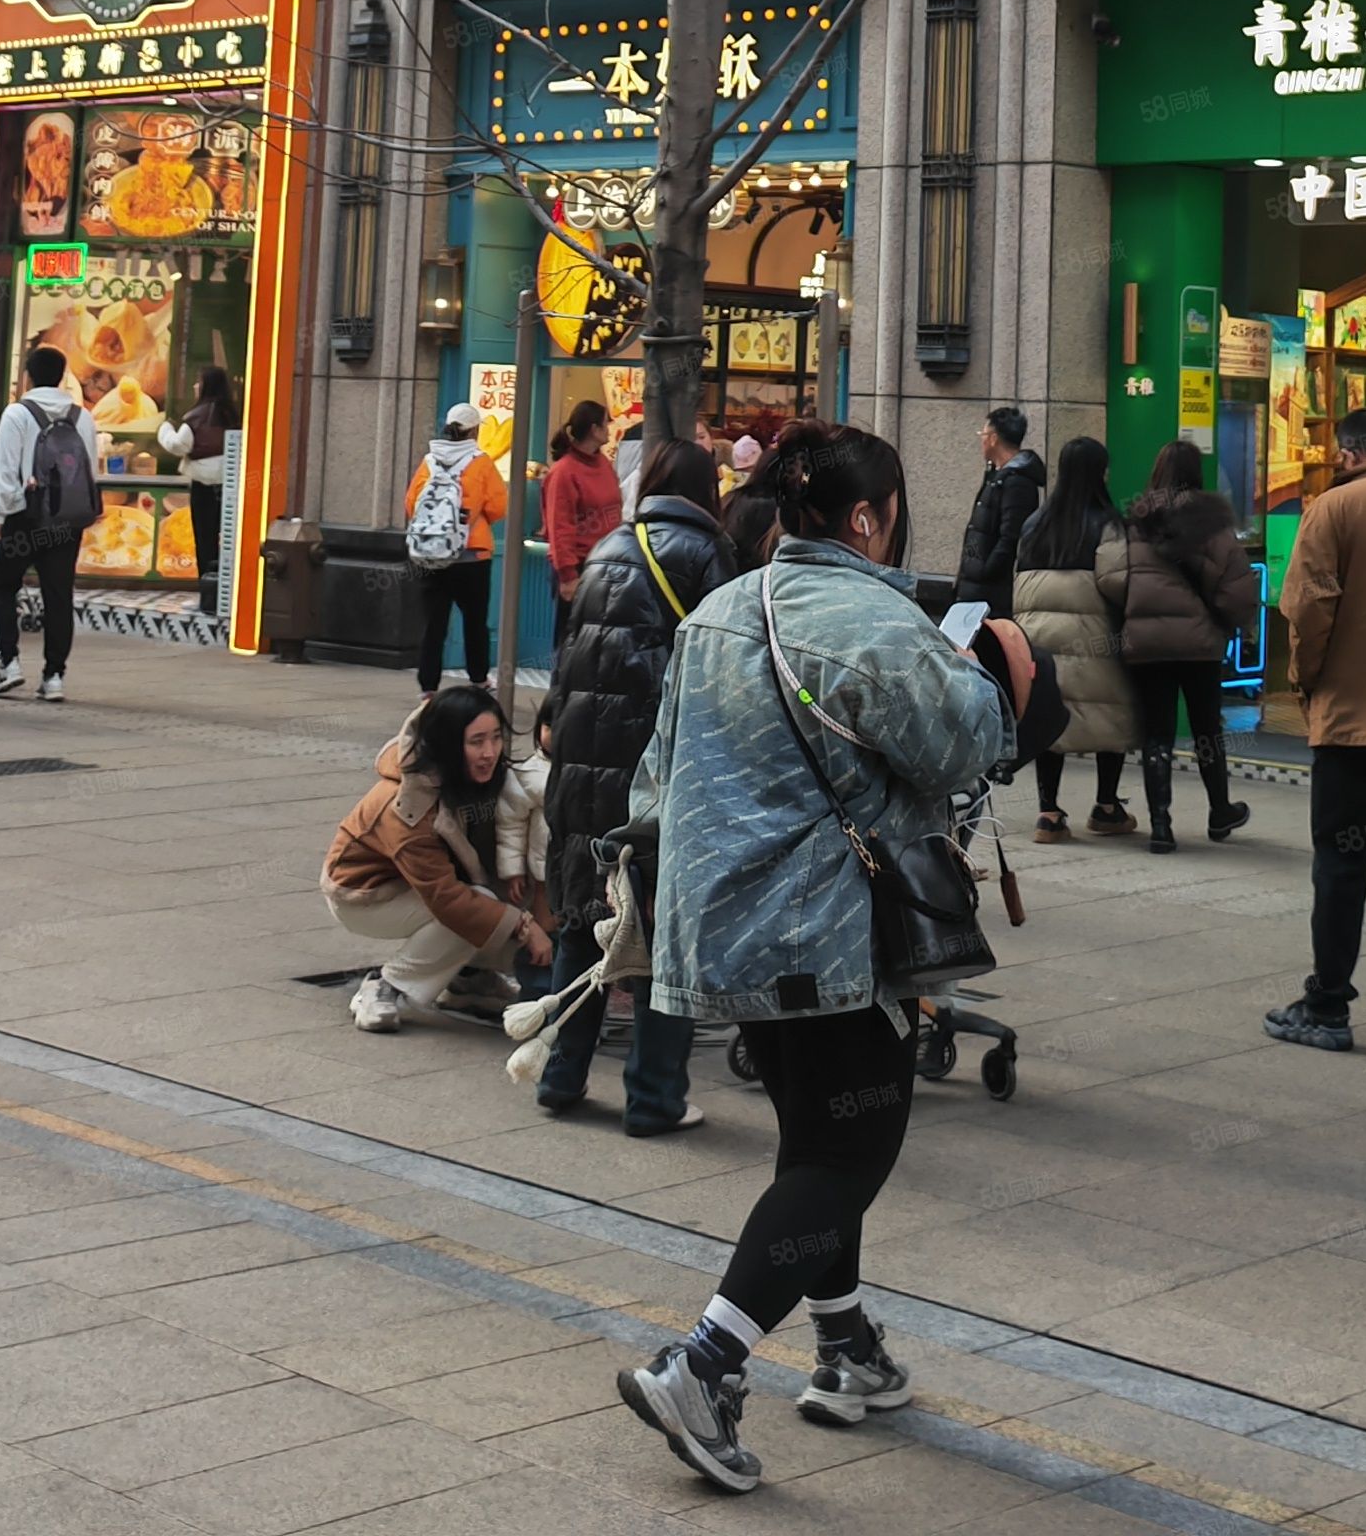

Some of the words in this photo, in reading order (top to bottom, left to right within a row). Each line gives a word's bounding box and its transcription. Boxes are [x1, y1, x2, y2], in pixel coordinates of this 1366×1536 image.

[1274, 66, 1365, 95] QINGZHI
[480, 370, 517, 389] 本店
[479, 391, 515, 411] 必吃
